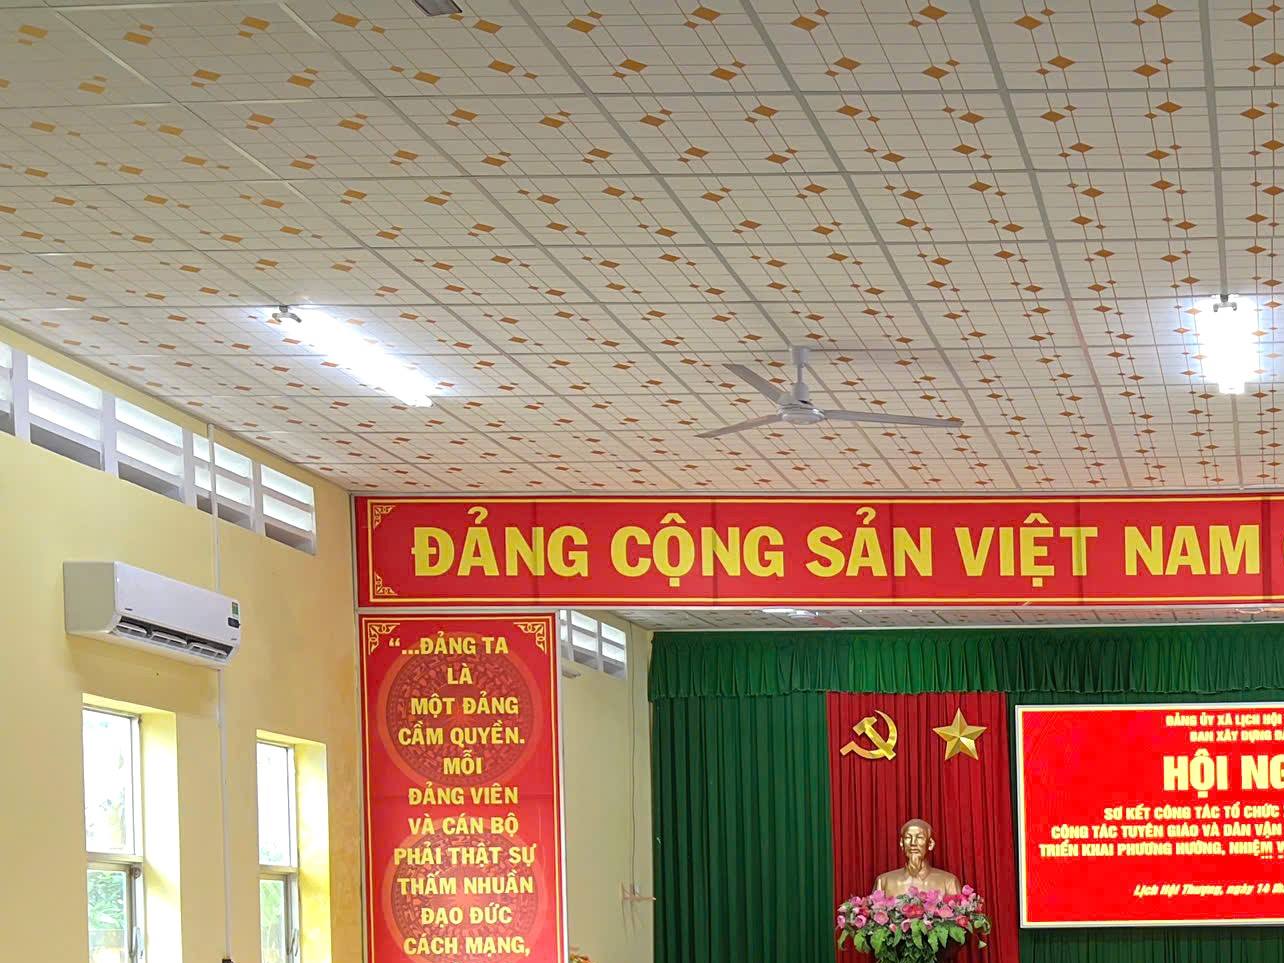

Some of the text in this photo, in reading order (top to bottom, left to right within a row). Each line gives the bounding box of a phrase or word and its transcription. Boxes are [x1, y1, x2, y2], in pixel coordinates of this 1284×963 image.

[411, 507, 589, 577] ĐẢNG
[610, 512, 785, 587] CỘNG
[806, 507, 933, 578] SẢN
[954, 512, 1098, 587] VIỆT
[1125, 525, 1260, 577] NAM
[482, 637, 508, 654] TA
[447, 663, 473, 684] LÀ
[411, 691, 519, 718] MỘT ĐẢNG
[398, 720, 525, 748] CẦM QUYỀN.
[443, 750, 482, 775] MỖI
[1163, 748, 1228, 798] HỘI
[408, 782, 518, 805] ĐẢNG VIÊN
[1126, 804, 1151, 820] KẾT
[1154, 805, 1191, 820] CÔNG
[1194, 803, 1220, 819] TÁC
[1244, 803, 1279, 818] CHỨC
[408, 813, 519, 837] VÀ CÁN BỘ
[1051, 824, 1089, 839] CÔNG
[1092, 823, 1118, 838] TÁC
[1167, 822, 1199, 837] GIÁO
[1202, 821, 1220, 837] VÀ
[1223, 821, 1250, 837] DÂN
[1255, 821, 1282, 838] VẬN
[394, 842, 537, 868] PHẢI THẬT SỰ
[1082, 843, 1114, 856] KHAI
[1229, 840, 1273, 856] NHIỆM
[397, 865, 533, 895] THẤM NHUẦN
[421, 903, 513, 928] ĐẠO ĐỨC
[404, 933, 530, 957] CÁCH MẠNG,
